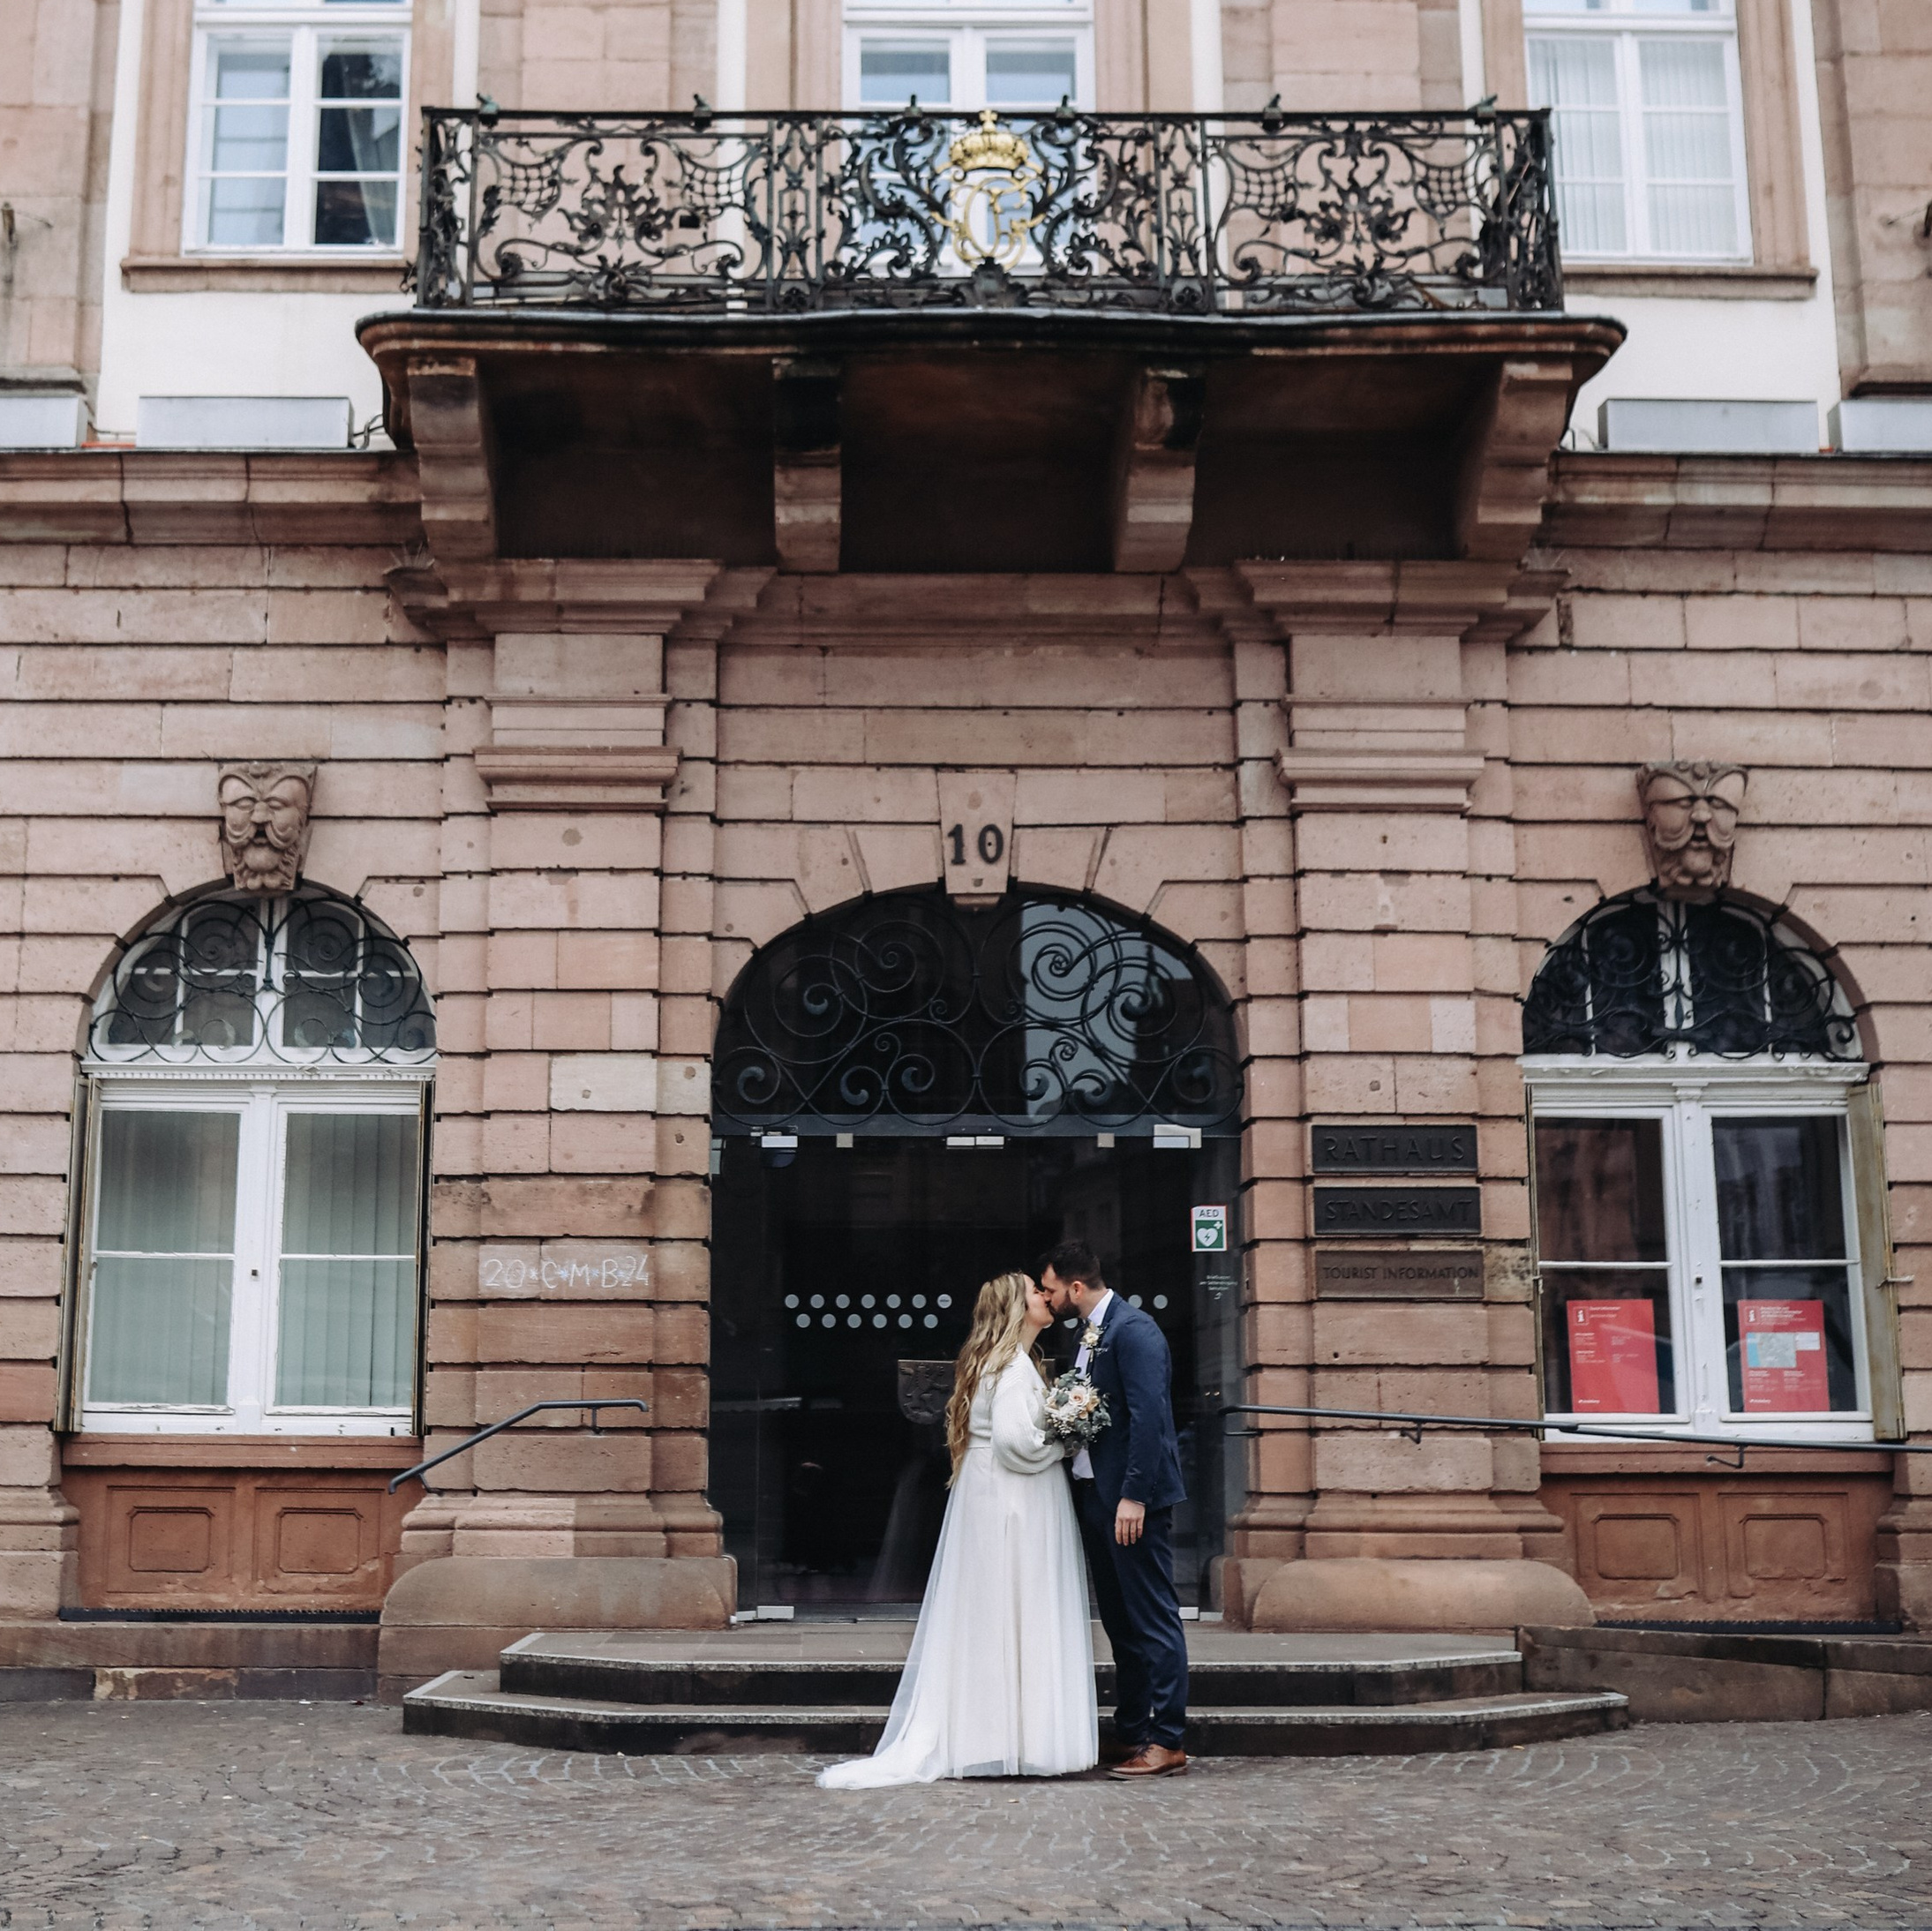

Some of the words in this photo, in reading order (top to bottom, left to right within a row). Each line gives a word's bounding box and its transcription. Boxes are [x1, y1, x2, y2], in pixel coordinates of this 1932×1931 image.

[947, 823, 1004, 865] 10
[1325, 1136, 1465, 1161] RATHAUS
[1199, 1209, 1220, 1218] AED
[1326, 1199, 1473, 1221] STANDESAMT
[1323, 1266, 1378, 1280] TOURIST
[1383, 1266, 1479, 1280] INFORMATION
